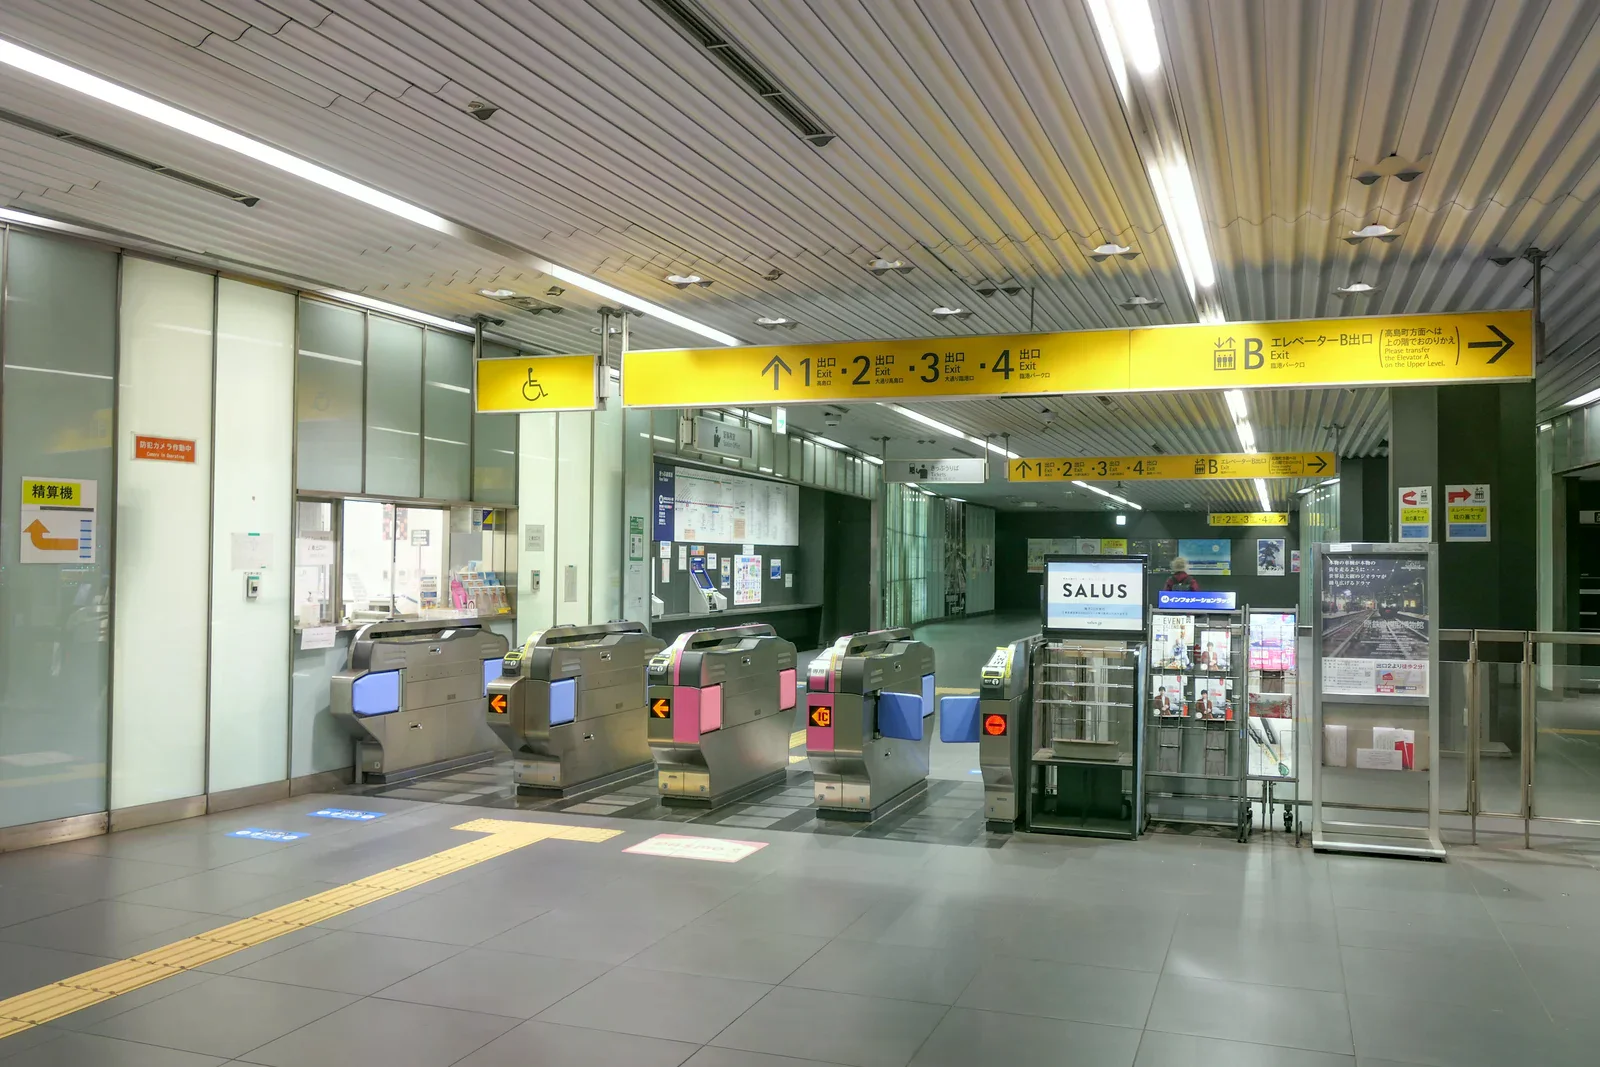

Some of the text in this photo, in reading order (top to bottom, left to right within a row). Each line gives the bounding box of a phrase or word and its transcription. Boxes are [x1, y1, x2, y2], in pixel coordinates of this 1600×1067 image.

[1384, 327, 1443, 337] 高島町方面へは
[1270, 333, 1373, 348] エレベーターB出口
[1384, 335, 1456, 347] 上の階でおのりかえ
[1244, 337, 1265, 370] B
[1270, 350, 1290, 360] Exit
[1406, 346, 1430, 354] transfer
[852, 355, 895, 385] 2 出口
[920, 351, 965, 383] 3 出口
[944, 364, 961, 374] Exit
[991, 348, 1041, 380] 4 出口
[1019, 361, 1036, 371] Exit
[1406, 360, 1426, 369] Upper
[799, 357, 836, 387] 1 出口
[816, 369, 832, 378] Exit
[875, 367, 891, 376] Exit
[139, 440, 192, 452] 防犯カメラ作動中
[1035, 462, 1042, 477] 1
[1062, 461, 1073, 477] 2
[1097, 460, 1108, 476] 3
[1132, 460, 1144, 476] 4
[1208, 459, 1218, 474] B
[31, 483, 74, 500] 精算機
[1226, 515, 1231, 524] 2
[1243, 515, 1249, 524] 3
[1261, 515, 1267, 523] 4
[1062, 582, 1128, 598] SALUS
[1163, 617, 1185, 625] EVENT
[817, 711, 829, 722] IC
